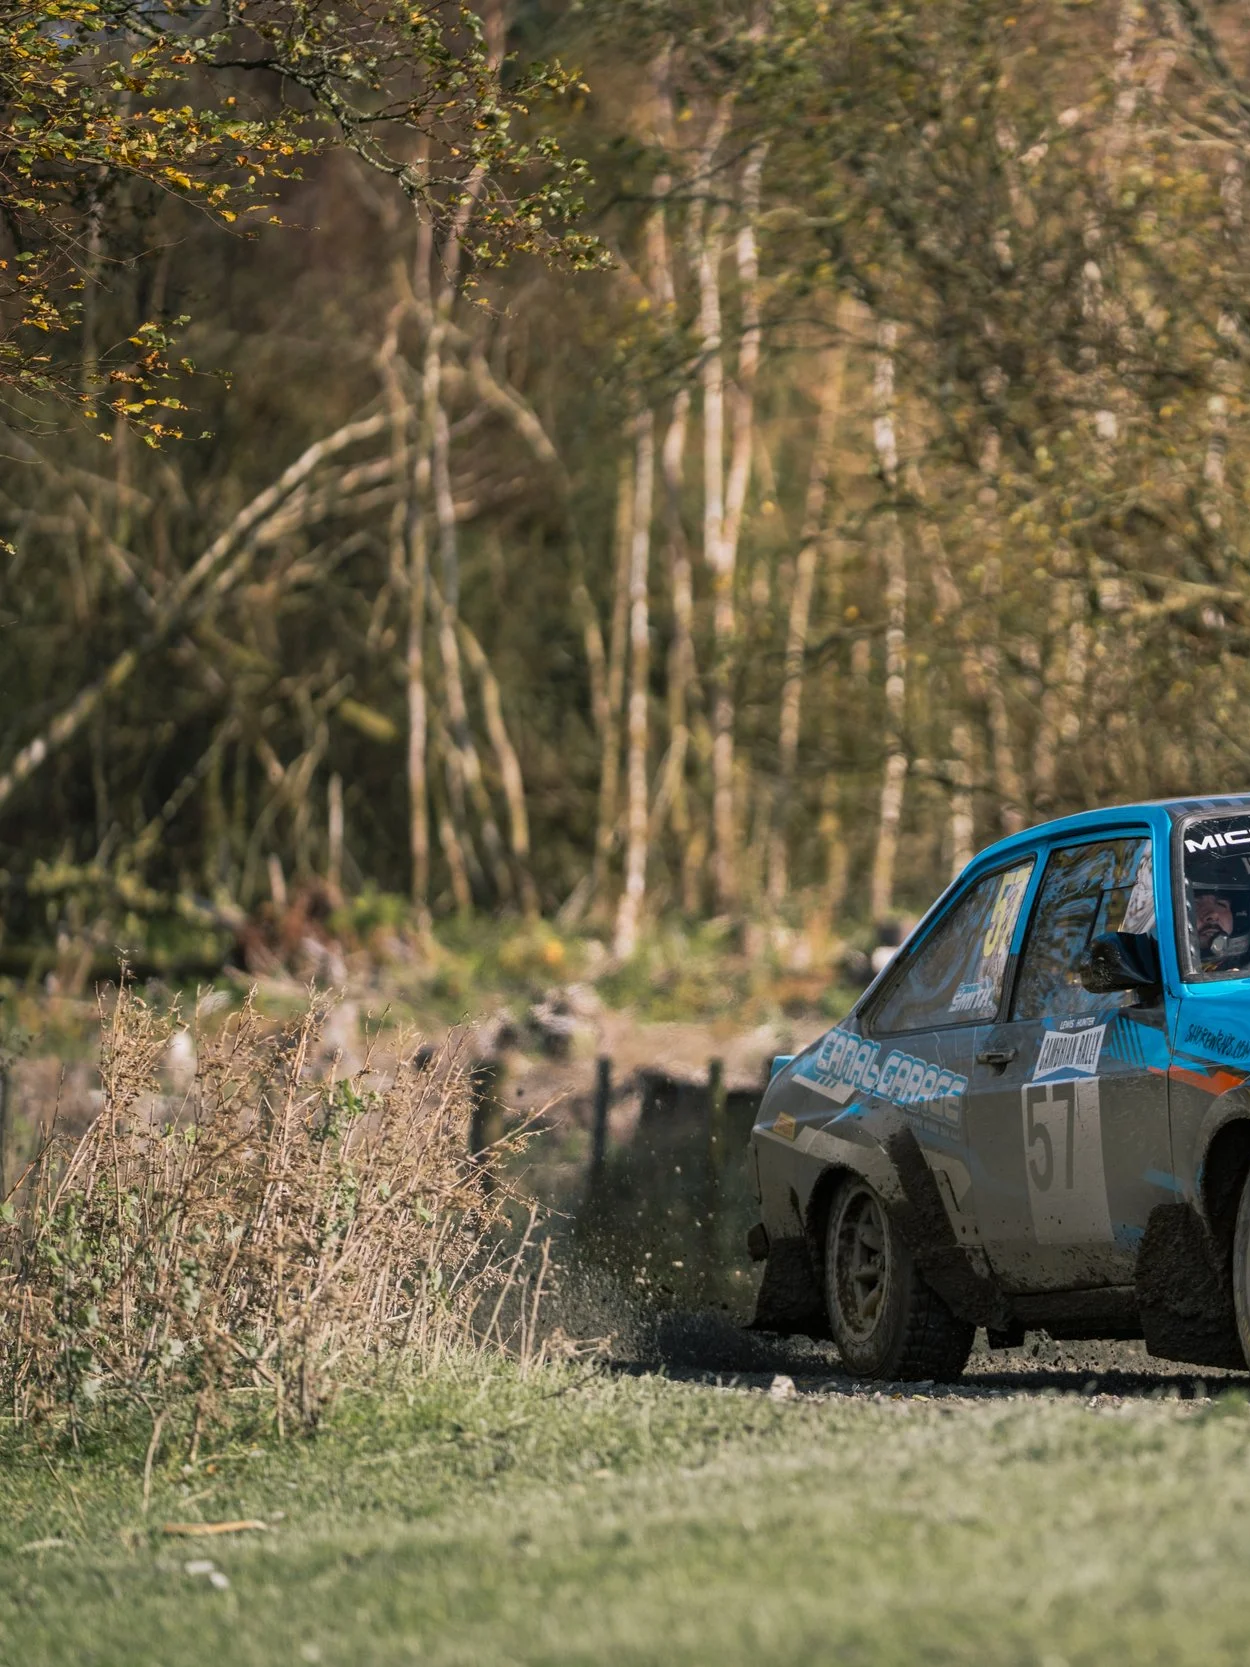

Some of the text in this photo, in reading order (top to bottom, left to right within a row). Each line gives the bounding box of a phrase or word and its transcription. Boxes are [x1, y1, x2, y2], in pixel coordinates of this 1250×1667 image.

[815, 1029, 881, 1094] CANAL
[873, 1049, 968, 1127] GARAGE
[1038, 1031, 1102, 1071] CAMBRIAN RALLY
[1026, 1081, 1076, 1192] 57
